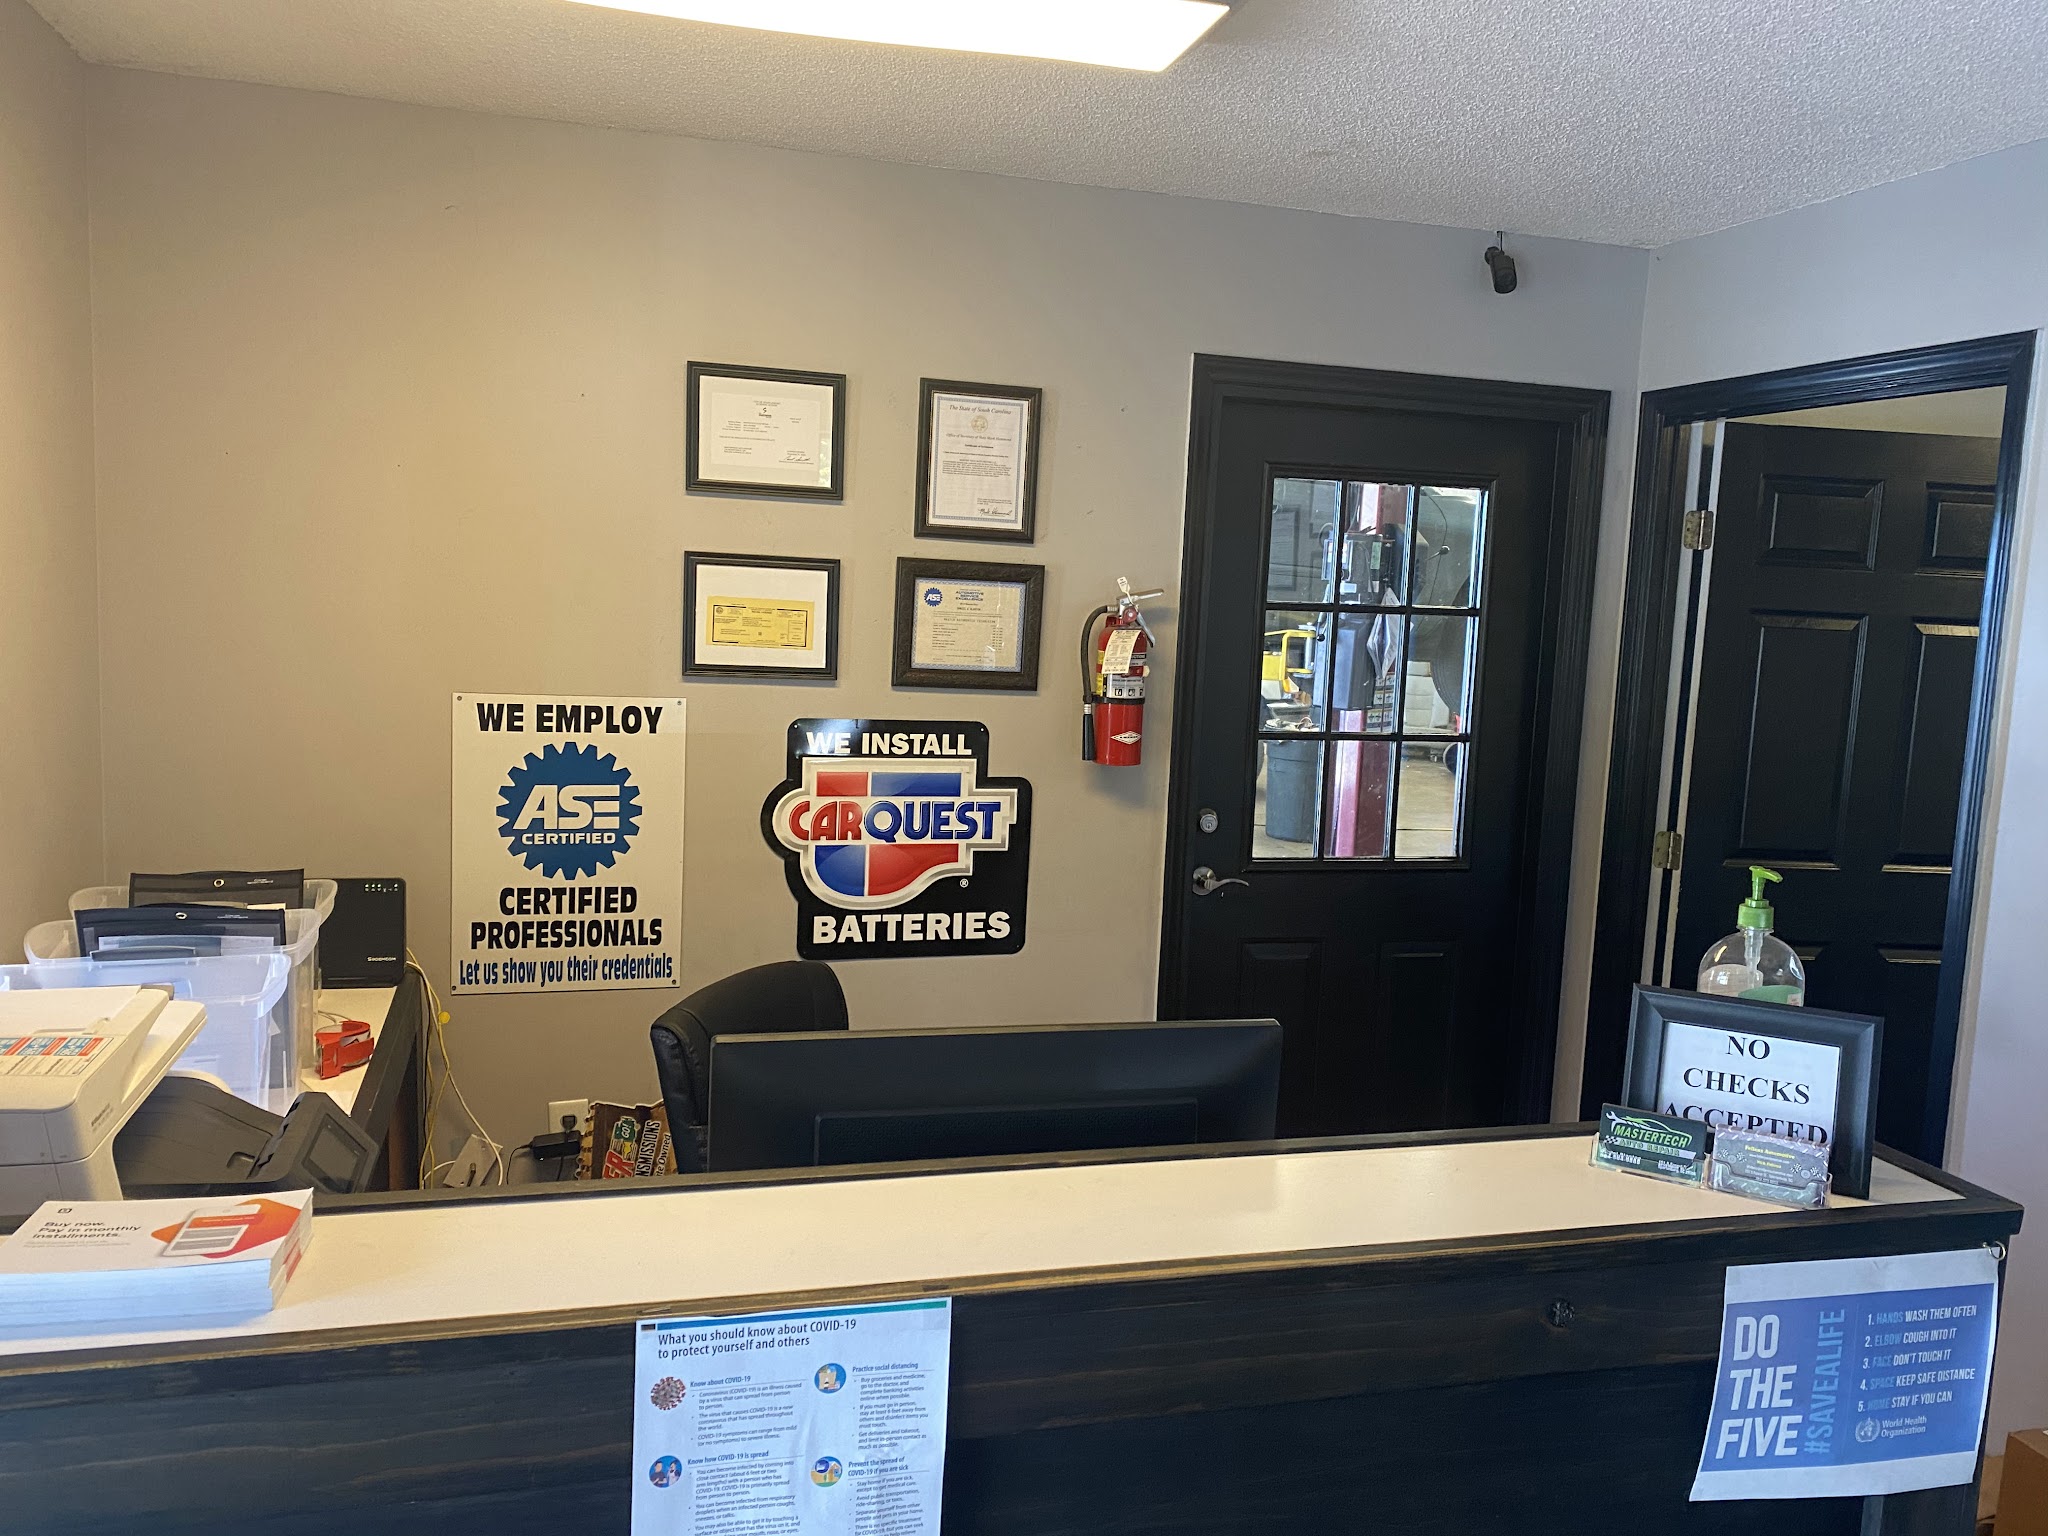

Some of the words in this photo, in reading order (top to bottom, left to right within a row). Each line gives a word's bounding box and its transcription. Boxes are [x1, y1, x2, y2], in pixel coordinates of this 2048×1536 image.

[926, 593, 941, 601] ASE
[477, 703, 524, 732] WE
[536, 704, 662, 734] EMPLOY
[807, 732, 850, 753] WE
[862, 733, 972, 755] INSTALL
[512, 784, 620, 830] ASE
[789, 801, 1001, 842] CARQUEST
[522, 833, 616, 844] CERTIFIED
[500, 886, 638, 915] CERTIFIED
[471, 919, 662, 950] PROFESSIONALS
[813, 911, 1010, 944] BATTERIES
[460, 960, 480, 985] Let
[484, 962, 498, 984] us
[502, 958, 536, 983] show
[540, 959, 563, 987] you
[567, 955, 598, 982] their
[602, 952, 672, 981] credentials
[1726, 1035, 1770, 1059] NO
[1684, 1067, 1809, 1104] CHECKS
[621, 1122, 631, 1138] GO!
[1614, 1125, 1687, 1148] MASTERTECH
[1868, 1314, 1874, 1325] 1.
[1876, 1312, 1904, 1325] HANDS
[1905, 1310, 1927, 1322] WASH
[1930, 1307, 1951, 1320] THEM
[1953, 1305, 1977, 1318] OFTEN
[659, 1334, 686, 1345] What
[689, 1335, 707, 1347] you
[710, 1328, 745, 1341] should
[747, 1325, 775, 1338] know
[777, 1322, 807, 1335] about
[810, 1319, 856, 1333] COVID-19
[1733, 1314, 1780, 1361] DO
[1865, 1336, 1872, 1348] 2.
[1875, 1333, 1900, 1346] ELBOW
[1903, 1331, 1929, 1344] COUGH
[1930, 1329, 1948, 1341] INTO
[1949, 1328, 1957, 1339] IT
[658, 1348, 668, 1359] to
[671, 1344, 709, 1360] protect
[712, 1339, 754, 1356] yourself
[756, 1337, 774, 1349] and
[777, 1336, 810, 1347] others
[1863, 1358, 1870, 1369] 3.
[1893, 1352, 1916, 1366] DON'T
[1918, 1350, 1942, 1363] TOUCH
[1944, 1349, 1951, 1360] IT
[725, 1376, 751, 1384] COVID-19
[1729, 1365, 1797, 1411] THE
[1804, 1308, 1845, 1455] #SAVEALIFE
[1860, 1380, 1868, 1391] 4.
[1870, 1377, 1895, 1390] SPACE
[1896, 1374, 1916, 1387] KEEP
[1917, 1372, 1936, 1384] SAFE
[1938, 1368, 1975, 1381] DISTANCE
[1858, 1401, 1865, 1412] 5.
[1892, 1395, 1910, 1408] STAY
[1912, 1394, 1919, 1405] IF
[1921, 1393, 1936, 1404] YOU
[1937, 1391, 1952, 1402] CAN
[1881, 1418, 1903, 1428] World
[1905, 1416, 1927, 1425] Health
[1881, 1426, 1926, 1438] Organization
[1715, 1414, 1803, 1459] FIVE
[718, 1453, 743, 1461] COVID-19
[750, 1450, 769, 1459] spread
[880, 1457, 898, 1465] spread
